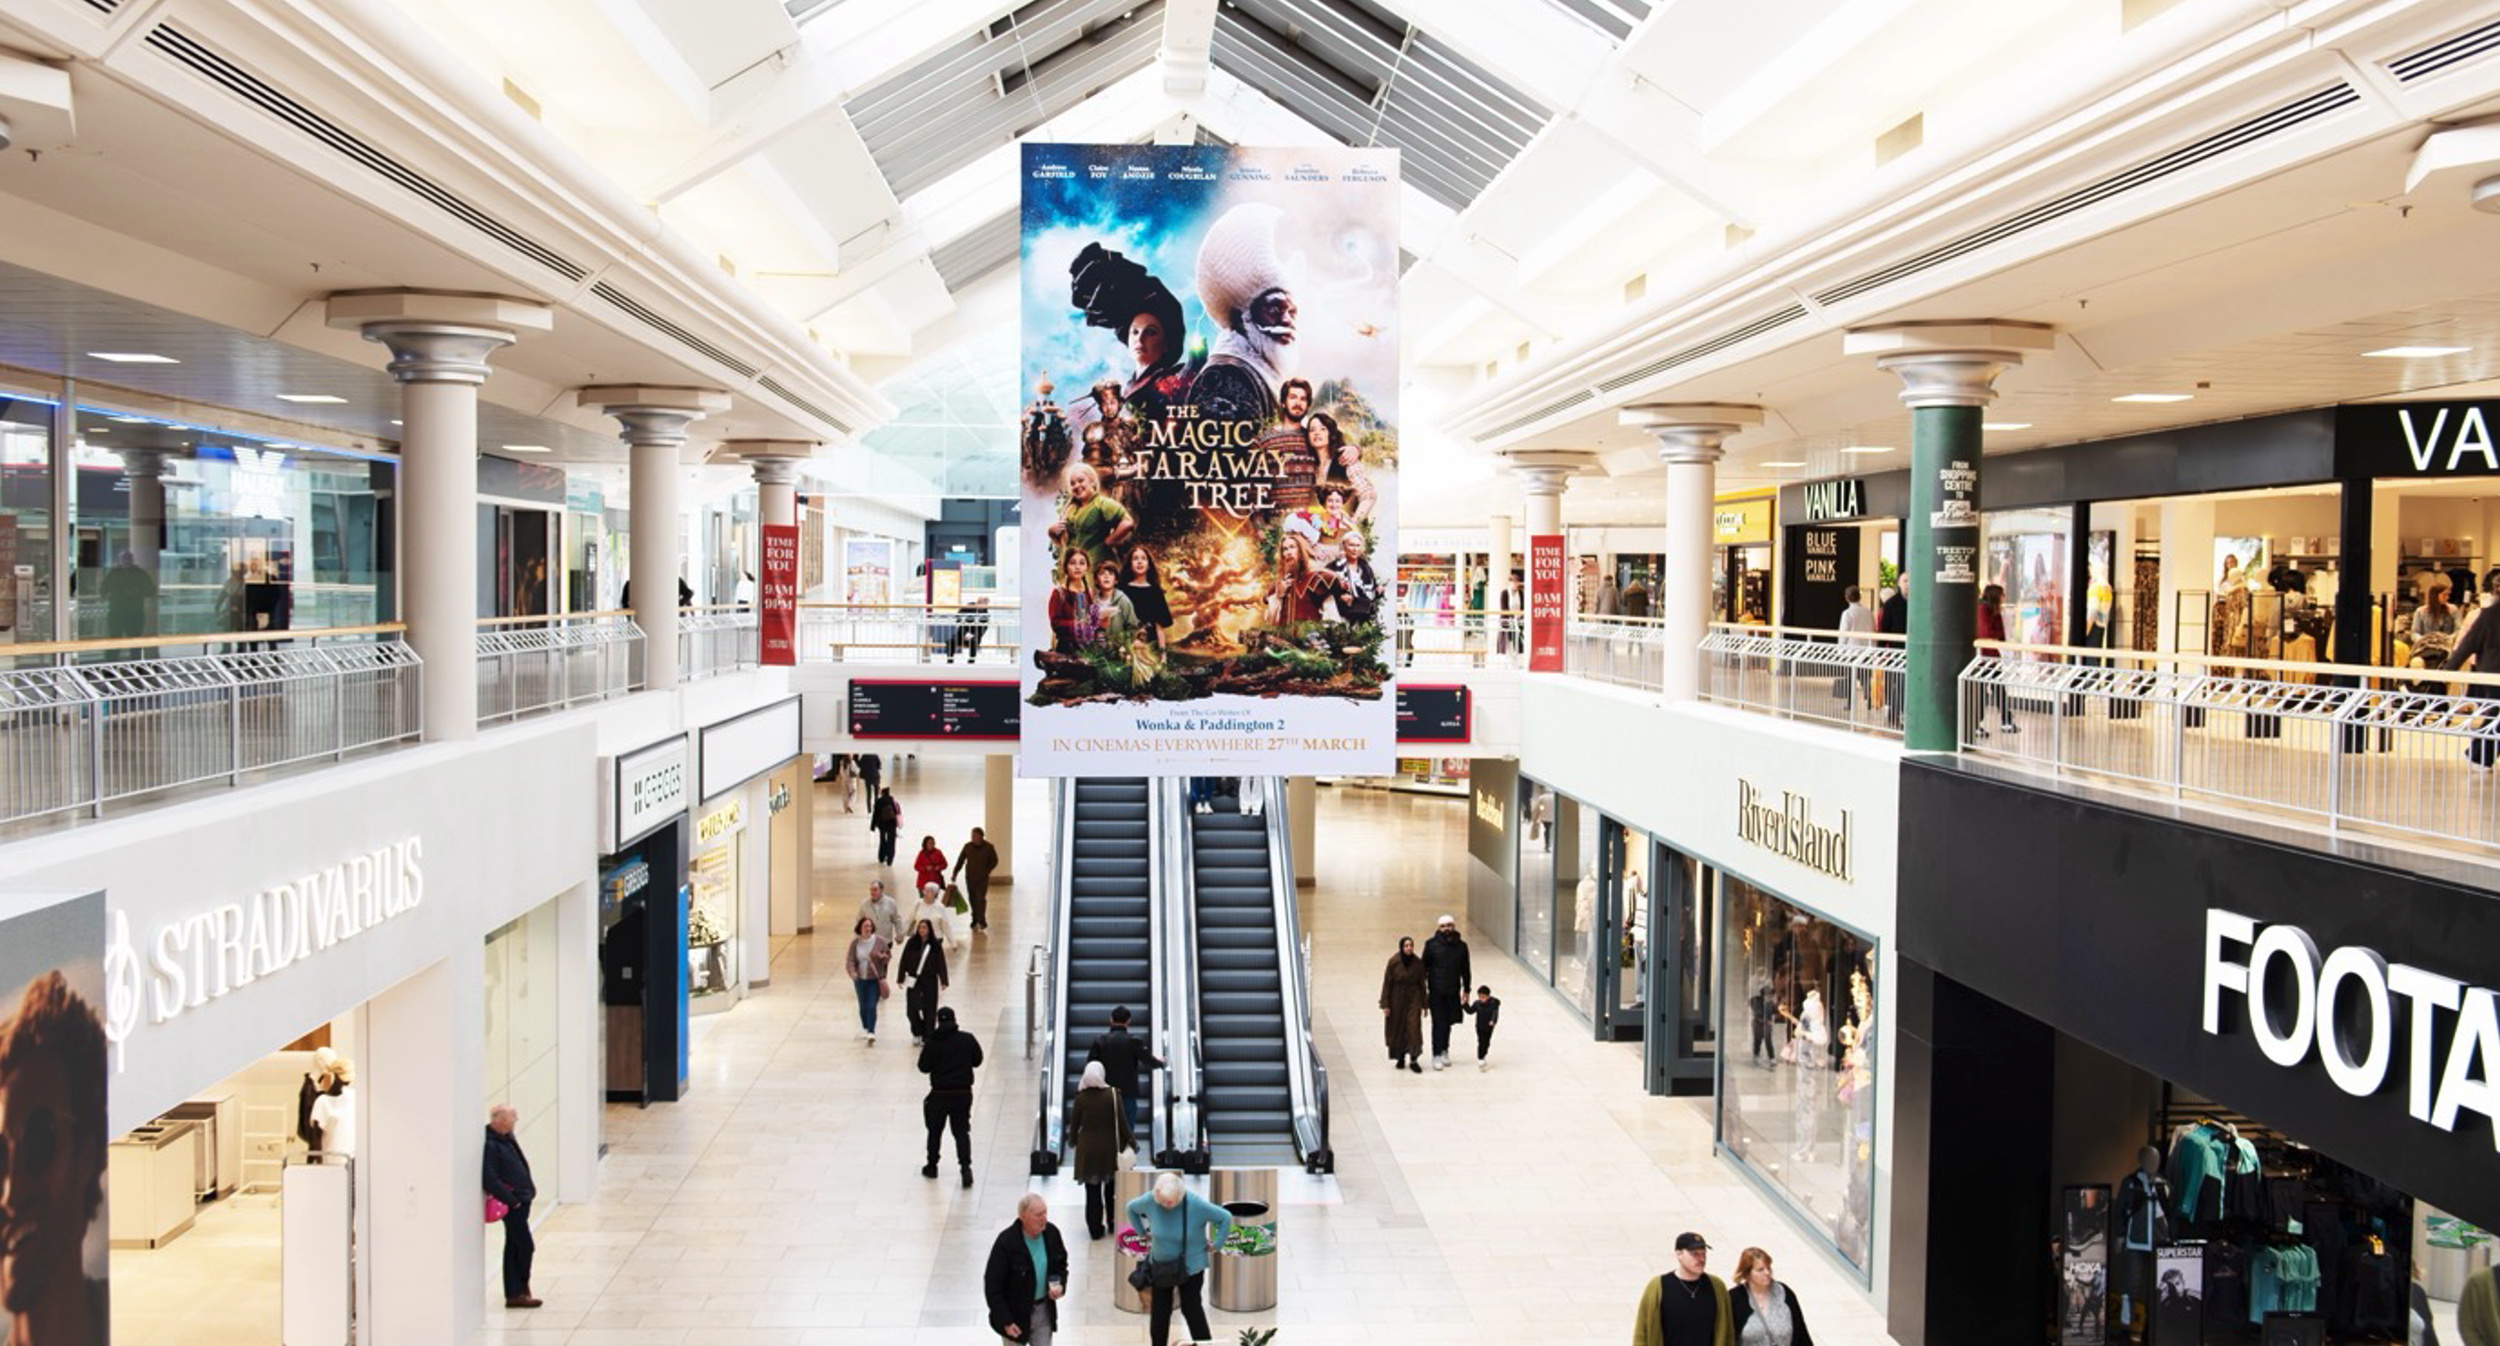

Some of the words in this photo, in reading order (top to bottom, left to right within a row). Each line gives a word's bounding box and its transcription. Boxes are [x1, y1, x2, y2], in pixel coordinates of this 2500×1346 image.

[1166, 405, 1200, 418] THE
[1146, 420, 1254, 454] MAGIC
[2398, 407, 2499, 471] VA
[1133, 449, 1294, 480] FARAWAY
[1944, 480, 1973, 491] CENTRE
[1185, 481, 1277, 520] TREE
[1804, 480, 1859, 519] VANILLA
[765, 537, 795, 547] TIME
[1806, 531, 1837, 547] BLUE
[766, 547, 795, 560] FOR
[1534, 547, 1561, 556] TIME
[1806, 546, 1837, 556] VANILLA
[766, 560, 794, 572] YOU
[1534, 557, 1561, 569] FOR
[1806, 559, 1837, 574] PINK
[1534, 569, 1560, 580] YOU
[765, 584, 794, 596] 9AM
[765, 598, 793, 610] 9PM
[1534, 593, 1561, 605] 9AM
[1534, 606, 1561, 618] 9PM
[1136, 719, 1180, 731] Wonka
[1184, 719, 1195, 731] &
[1200, 719, 1275, 733] Paddington
[1277, 719, 1286, 730] 2
[1053, 739, 1071, 752] IN
[1074, 739, 1151, 752] CINEMAS
[1155, 739, 1264, 751] EVERYWHERE
[1302, 738, 1367, 751] MARCH
[644, 763, 682, 809] GREGGS
[153, 836, 423, 1024] STRADIVARIUS
[2156, 1247, 2203, 1258] SUPERSTAR
[2069, 1261, 2101, 1272] HOKA
